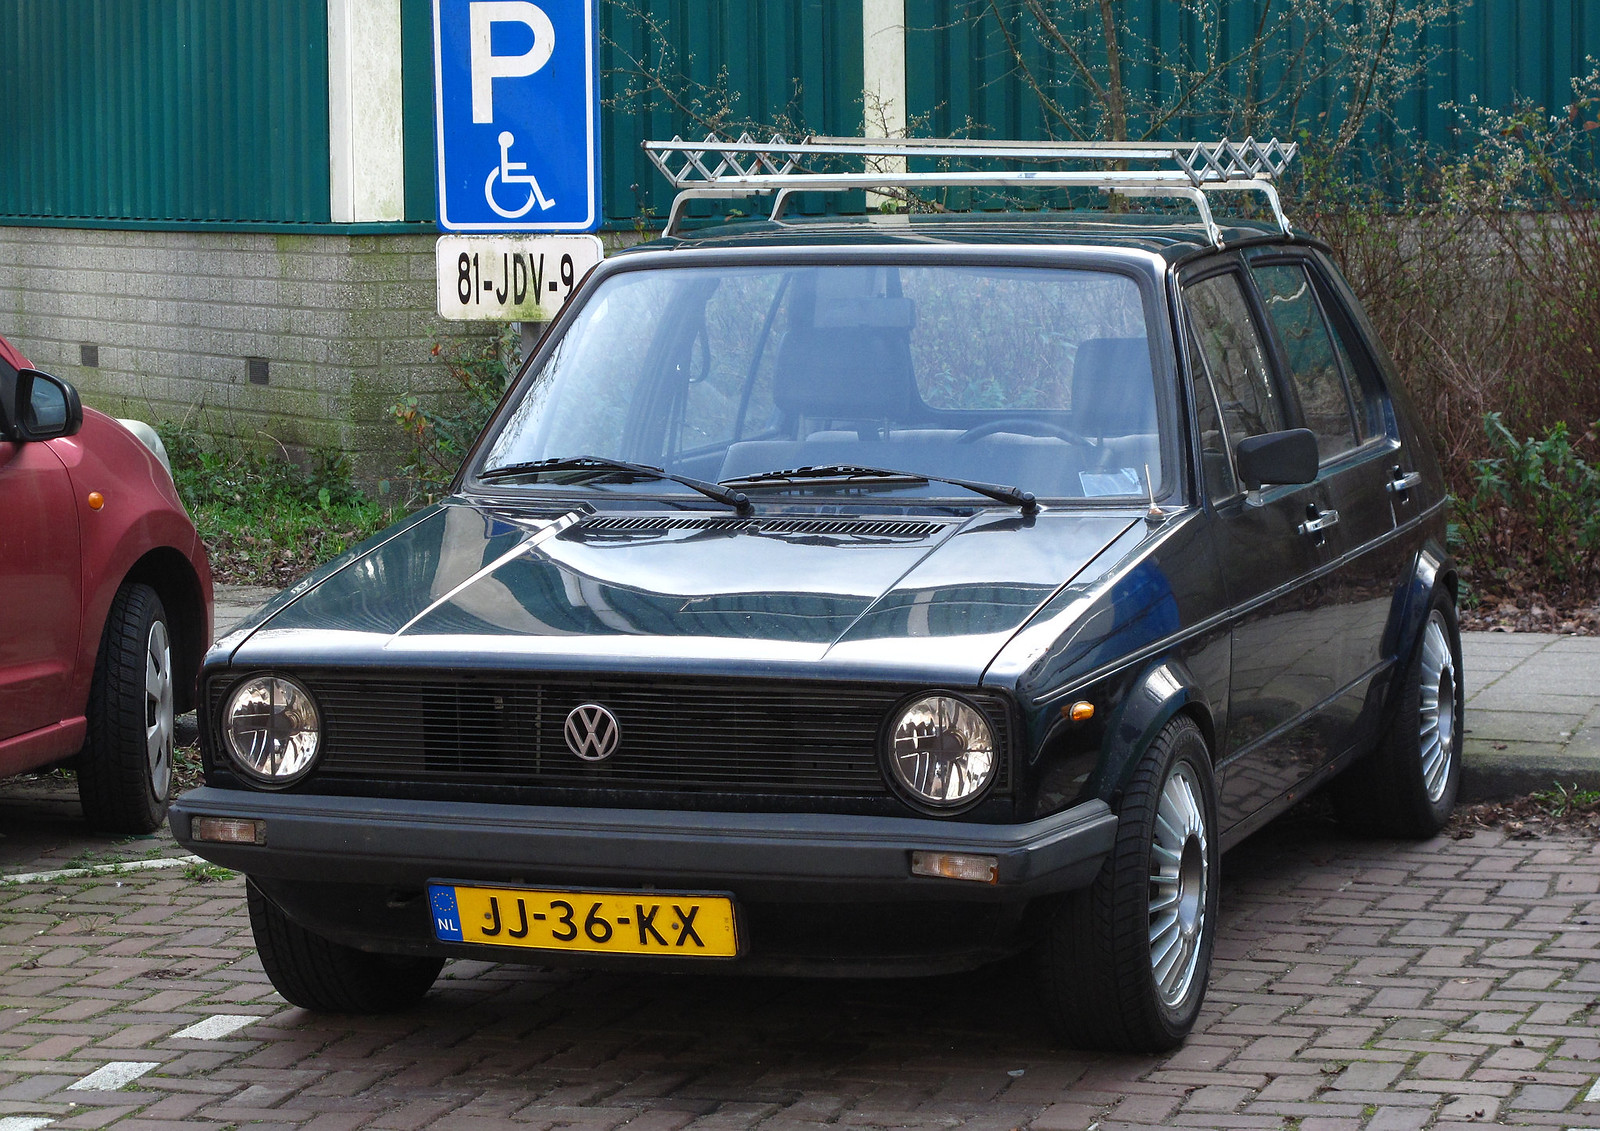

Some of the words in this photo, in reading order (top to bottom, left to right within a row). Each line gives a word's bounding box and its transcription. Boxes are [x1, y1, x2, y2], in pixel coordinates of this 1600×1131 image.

[469, 1, 555, 124] P
[457, 252, 574, 305] 81-JDV-9
[564, 704, 619, 760] VW
[437, 918, 458, 931] NL
[481, 896, 705, 947] JJ-36-KX
